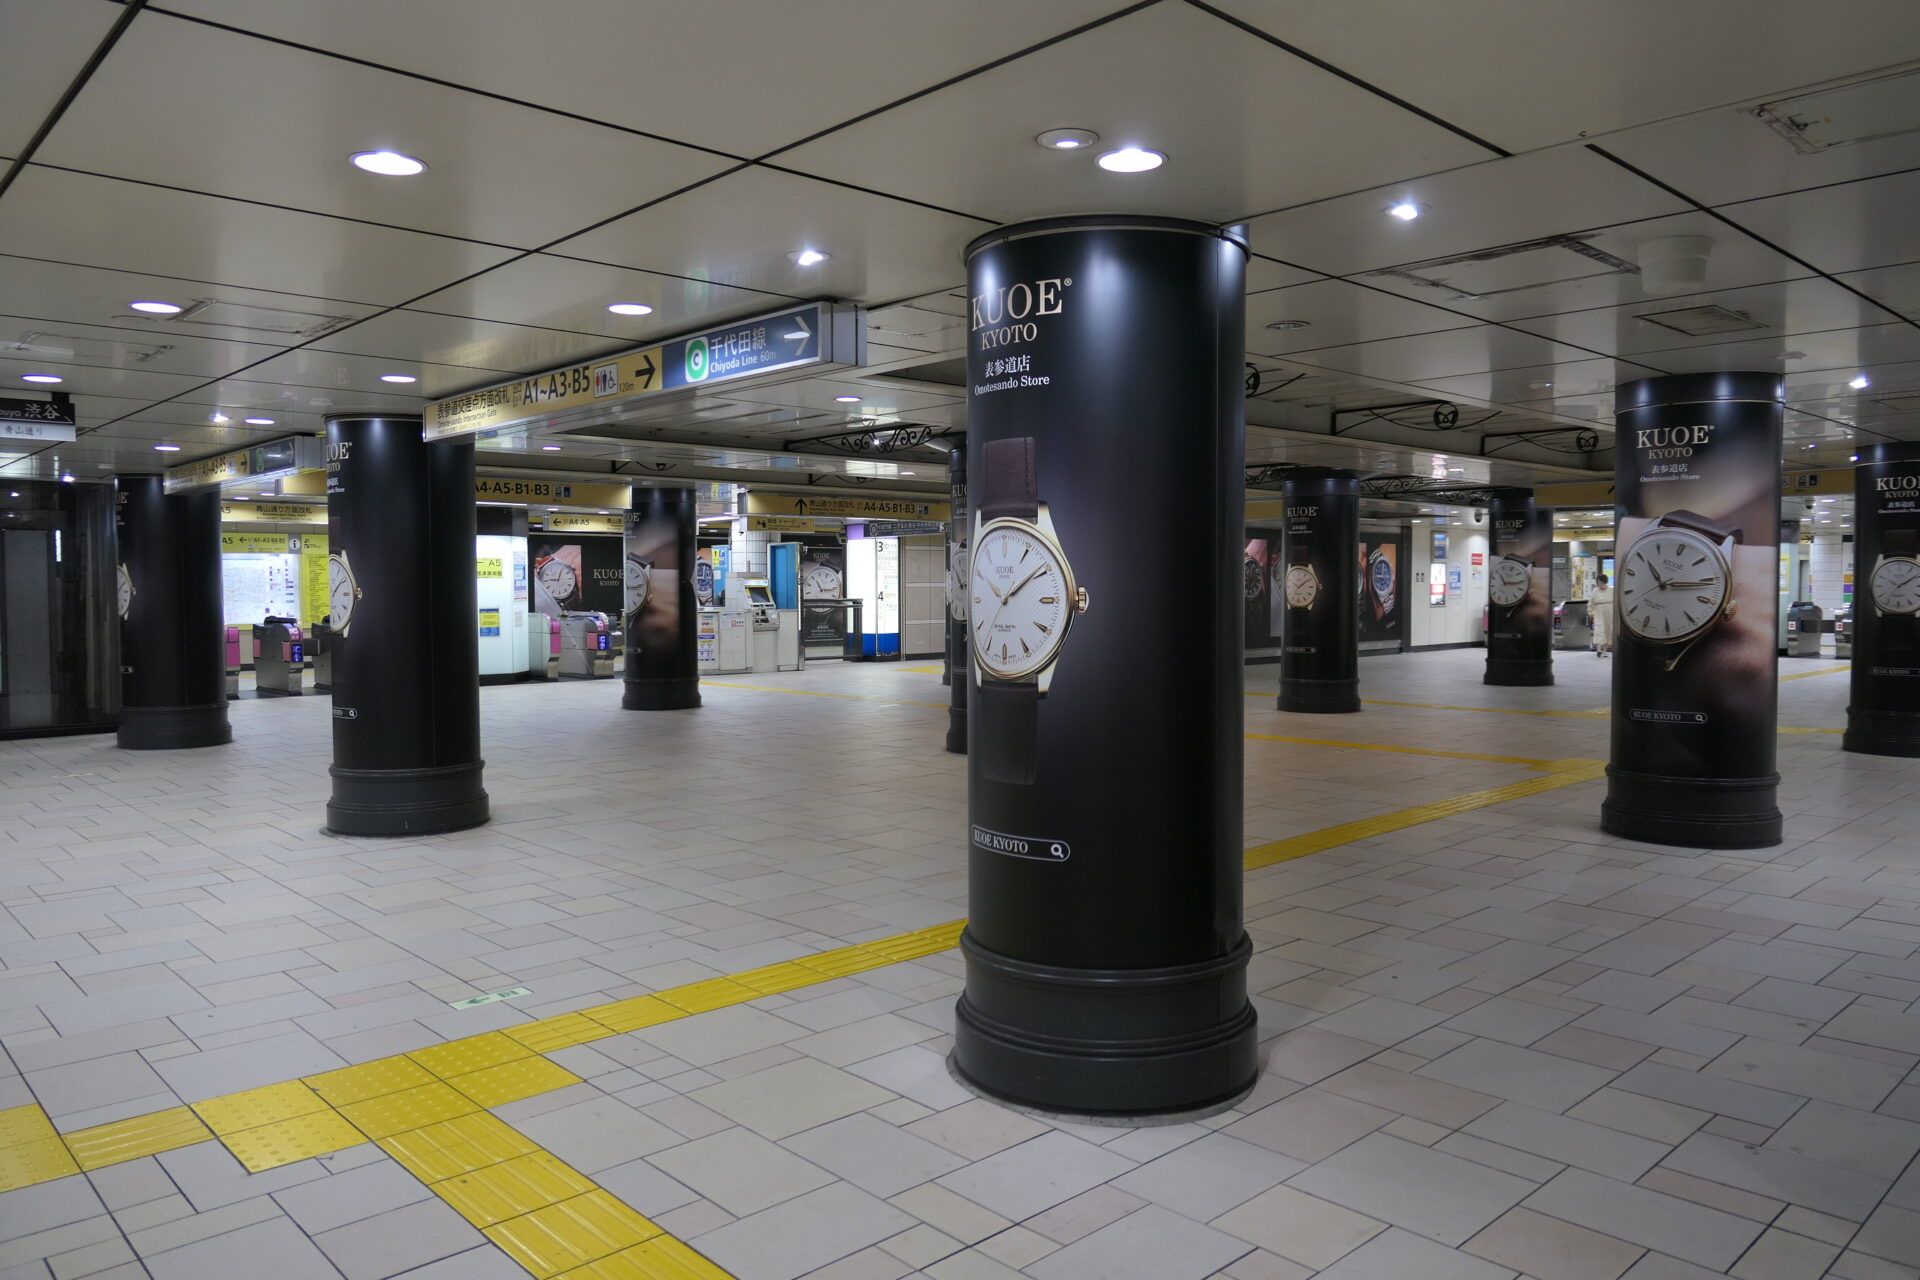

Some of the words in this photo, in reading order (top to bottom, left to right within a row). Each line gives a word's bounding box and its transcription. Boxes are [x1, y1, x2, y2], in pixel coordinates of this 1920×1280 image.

[981, 322, 1038, 350] KYOTO
[710, 327, 767, 360] 千代田線
[710, 359, 741, 374] Chiyoda
[742, 354, 758, 367] Line
[760, 350, 778, 362] 60m
[985, 355, 1031, 378] 表参道店
[974, 377, 1019, 396] Omotesando
[1020, 375, 1050, 387] Store
[437, 385, 510, 420] 表参道交差点方面改札
[25, 403, 61, 419] 渋谷
[1636, 425, 1709, 448] KUOE
[1648, 446, 1693, 460] KYOTO
[1652, 463, 1689, 474] 表参道店
[1680, 473, 1701, 481] Store
[1885, 490, 1919, 499] KYOTO
[222, 537, 233, 545] A5
[878, 541, 884, 552] 3
[488, 559, 502, 568] A5
[996, 566, 1015, 574] KUOE
[877, 591, 884, 601] 4
[1653, 712, 1681, 720] KYOTO
[974, 829, 992, 847] KUOE
[993, 834, 1029, 855] KYOTO
